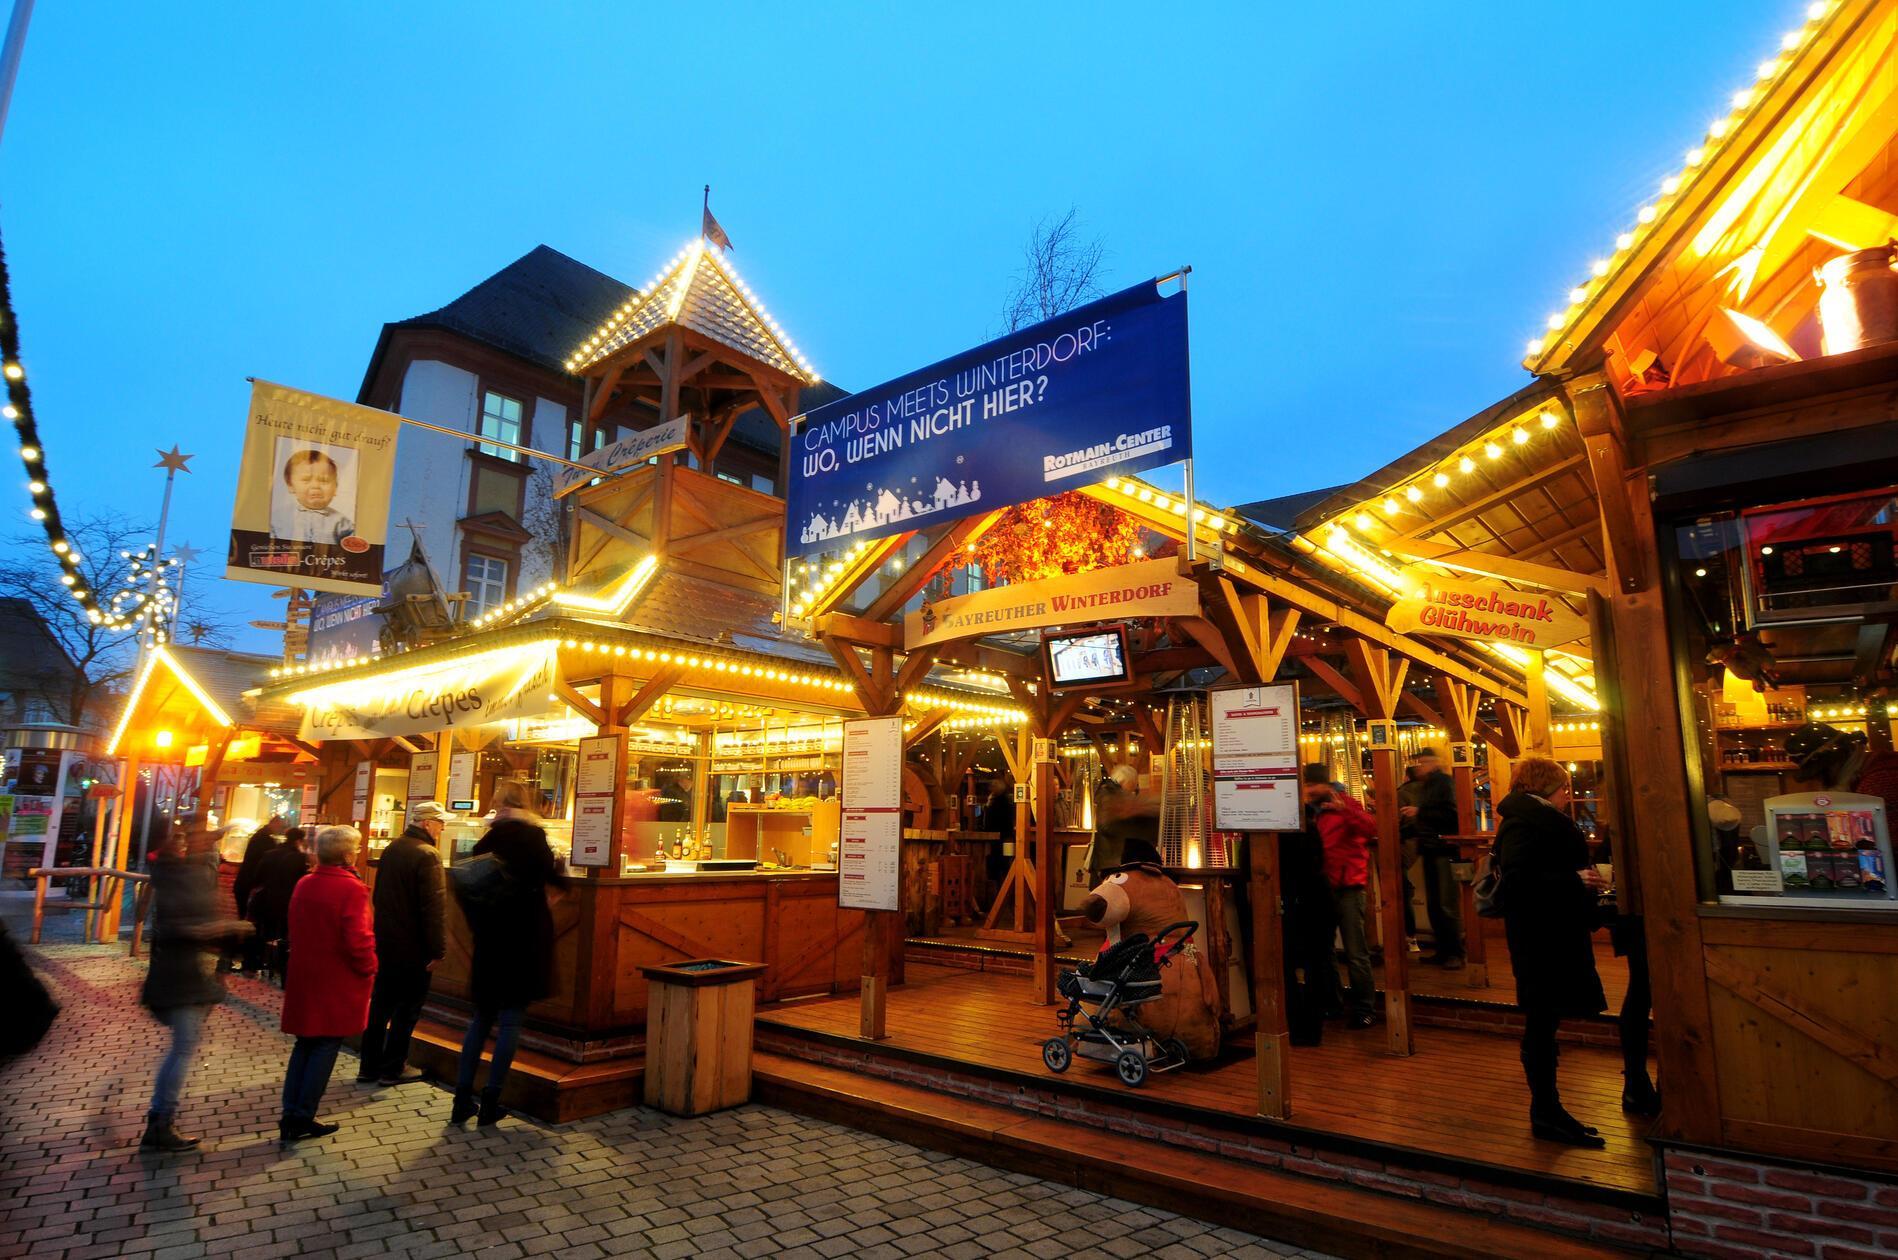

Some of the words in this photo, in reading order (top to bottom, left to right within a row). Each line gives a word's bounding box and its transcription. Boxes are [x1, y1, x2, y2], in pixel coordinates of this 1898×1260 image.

[804, 405, 879, 451] CAMPUS
[887, 379, 949, 423] MEETS
[956, 320, 1112, 398] WINTERDORF:
[255, 414, 294, 430] Heute
[297, 423, 326, 436] nicht
[329, 430, 351, 442] gut
[353, 431, 391, 451] drauf?
[803, 448, 839, 478] WO,
[846, 424, 902, 464] WENN
[910, 399, 975, 444] NICHT
[983, 375, 1048, 420] HIER?
[1043, 425, 1172, 472] ROTMAIN-CENTER
[943, 603, 1046, 628] BAYREUTHER
[1051, 582, 1173, 614] WINTERDORF
[1420, 605, 1536, 644] Glühwein
